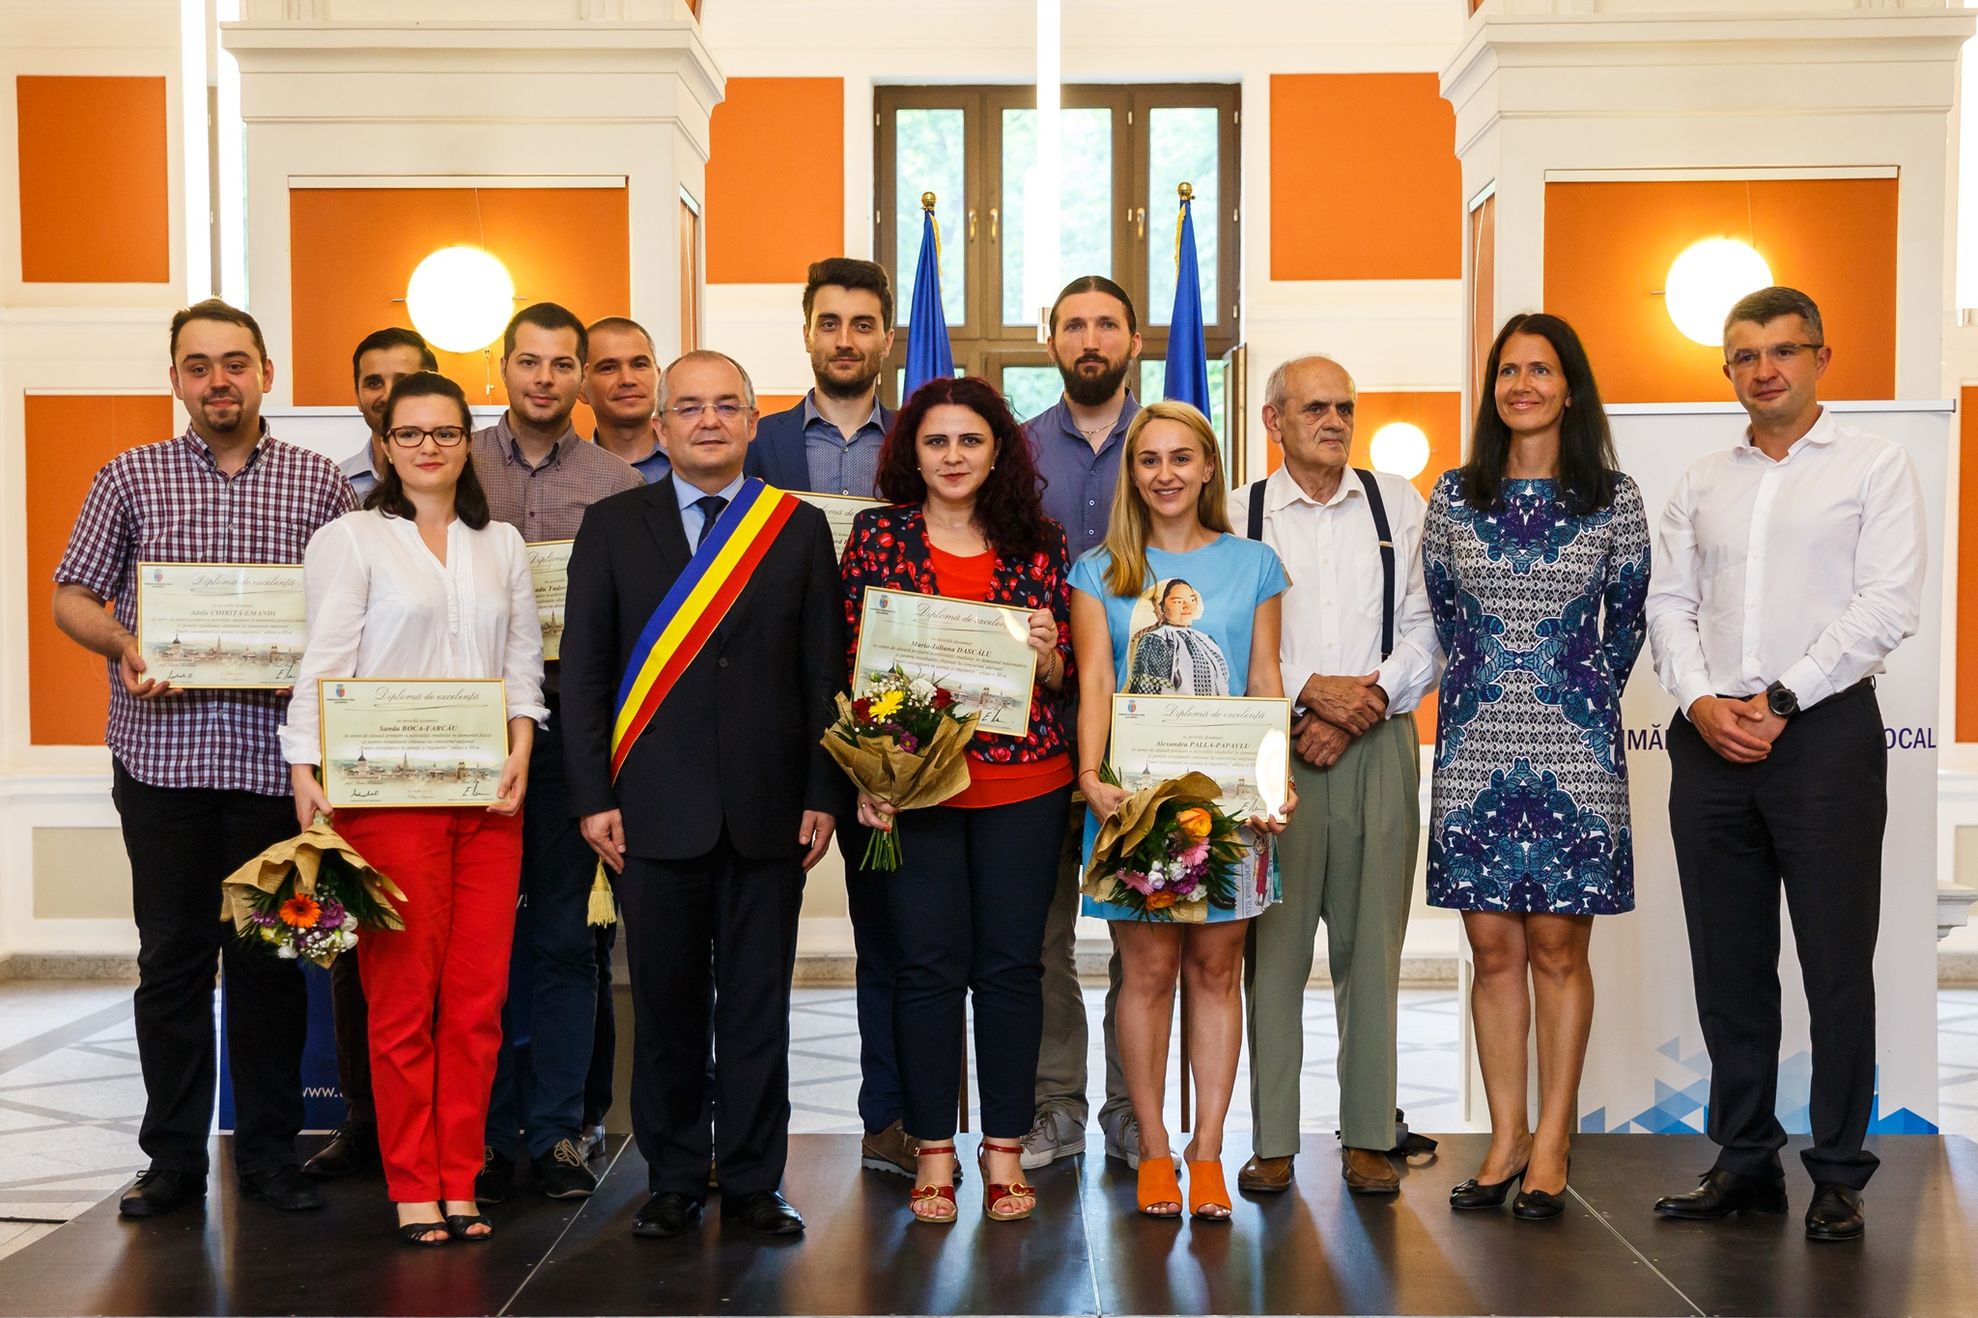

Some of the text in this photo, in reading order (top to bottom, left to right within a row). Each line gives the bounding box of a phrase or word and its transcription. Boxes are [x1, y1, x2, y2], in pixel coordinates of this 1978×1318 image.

[961, 614, 973, 623] de
[424, 691, 435, 701] de
[1210, 708, 1222, 718] de
[1156, 740, 1188, 748] Alexandra
